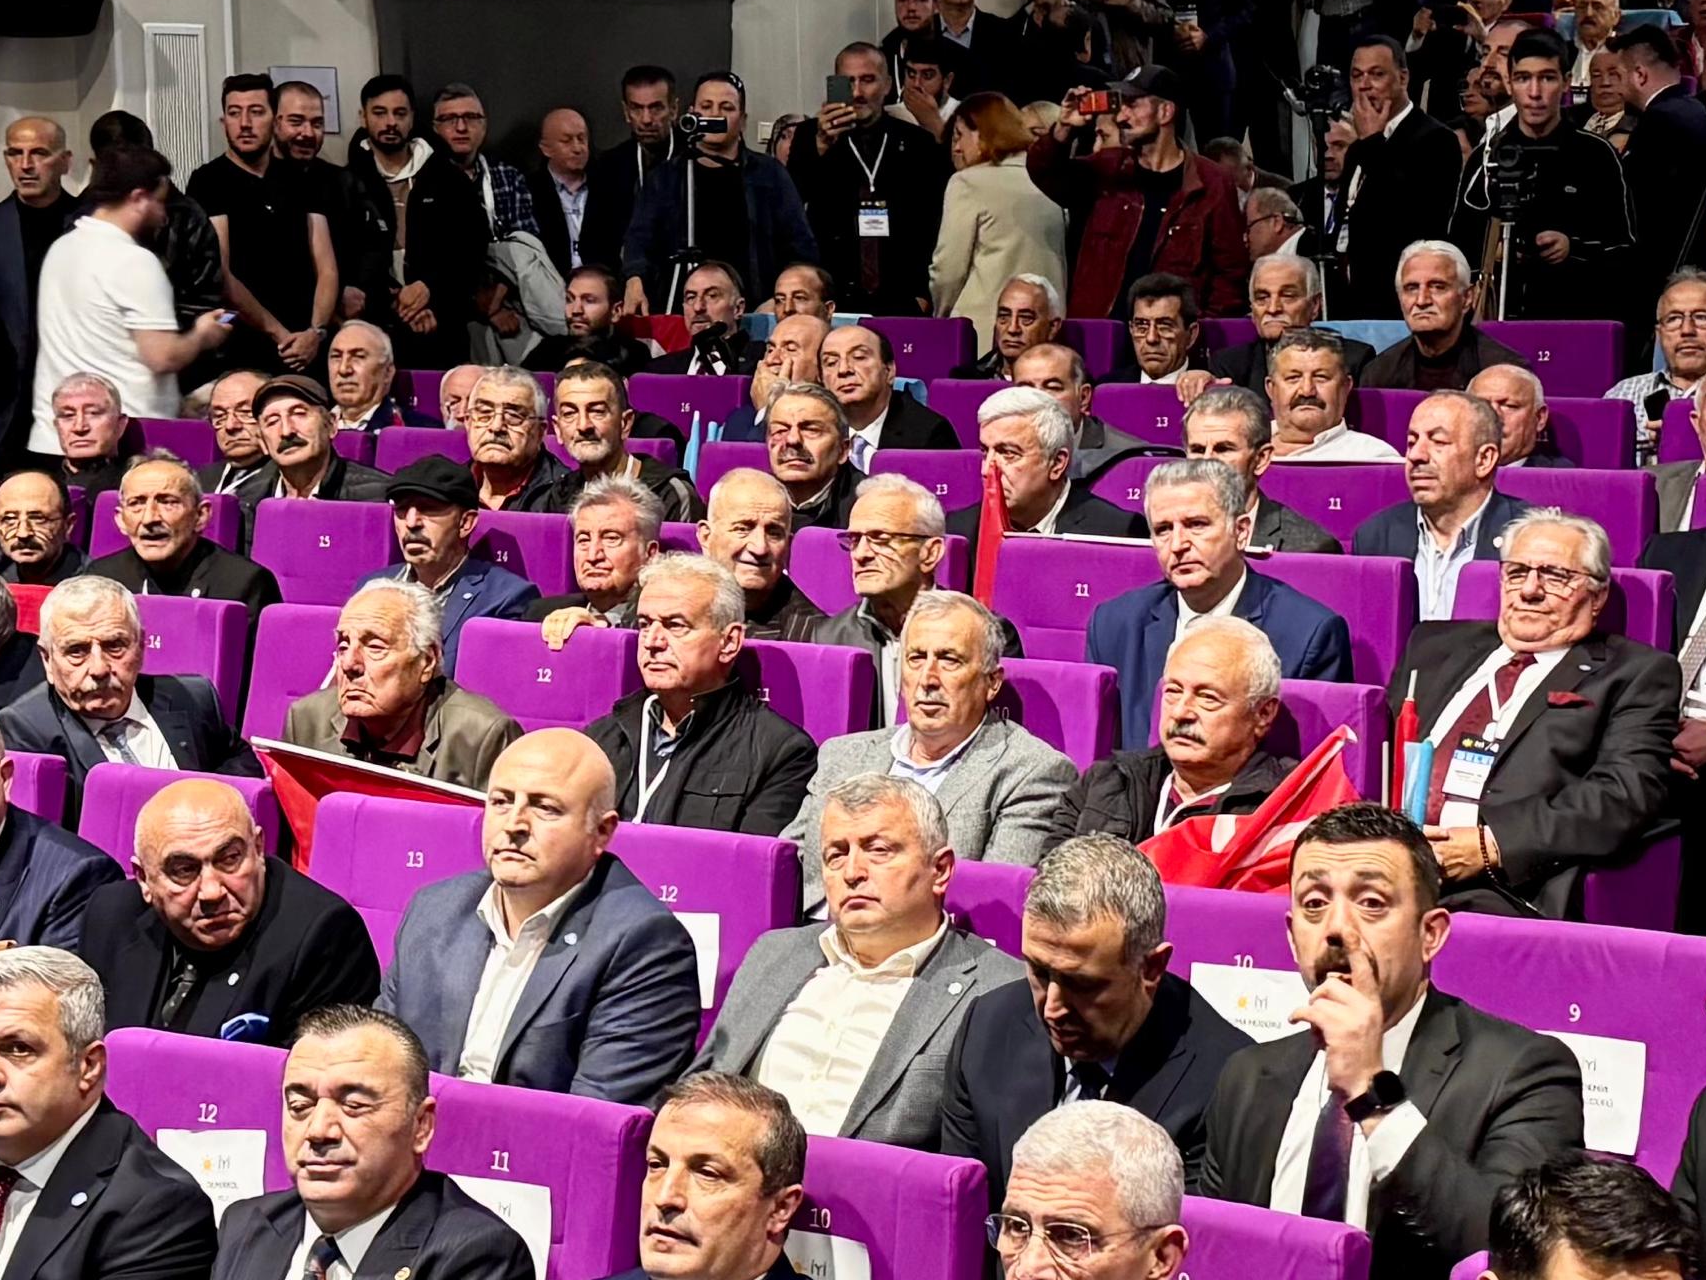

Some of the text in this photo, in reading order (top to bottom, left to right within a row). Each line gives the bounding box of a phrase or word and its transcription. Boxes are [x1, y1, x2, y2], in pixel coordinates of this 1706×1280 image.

[1537, 351, 1550, 361] 12
[1156, 417, 1168, 427] 13
[1127, 488, 1141, 500] 12
[1328, 497, 1342, 510] 11
[1075, 583, 1090, 597] 11
[537, 668, 552, 682] 12
[406, 851, 424, 868] 13
[658, 885, 678, 902] 12
[1234, 954, 1254, 969] 10
[1569, 1003, 1581, 1022] 9
[198, 1103, 218, 1124] 12
[490, 1150, 510, 1172] 11
[809, 1208, 831, 1229] 10
